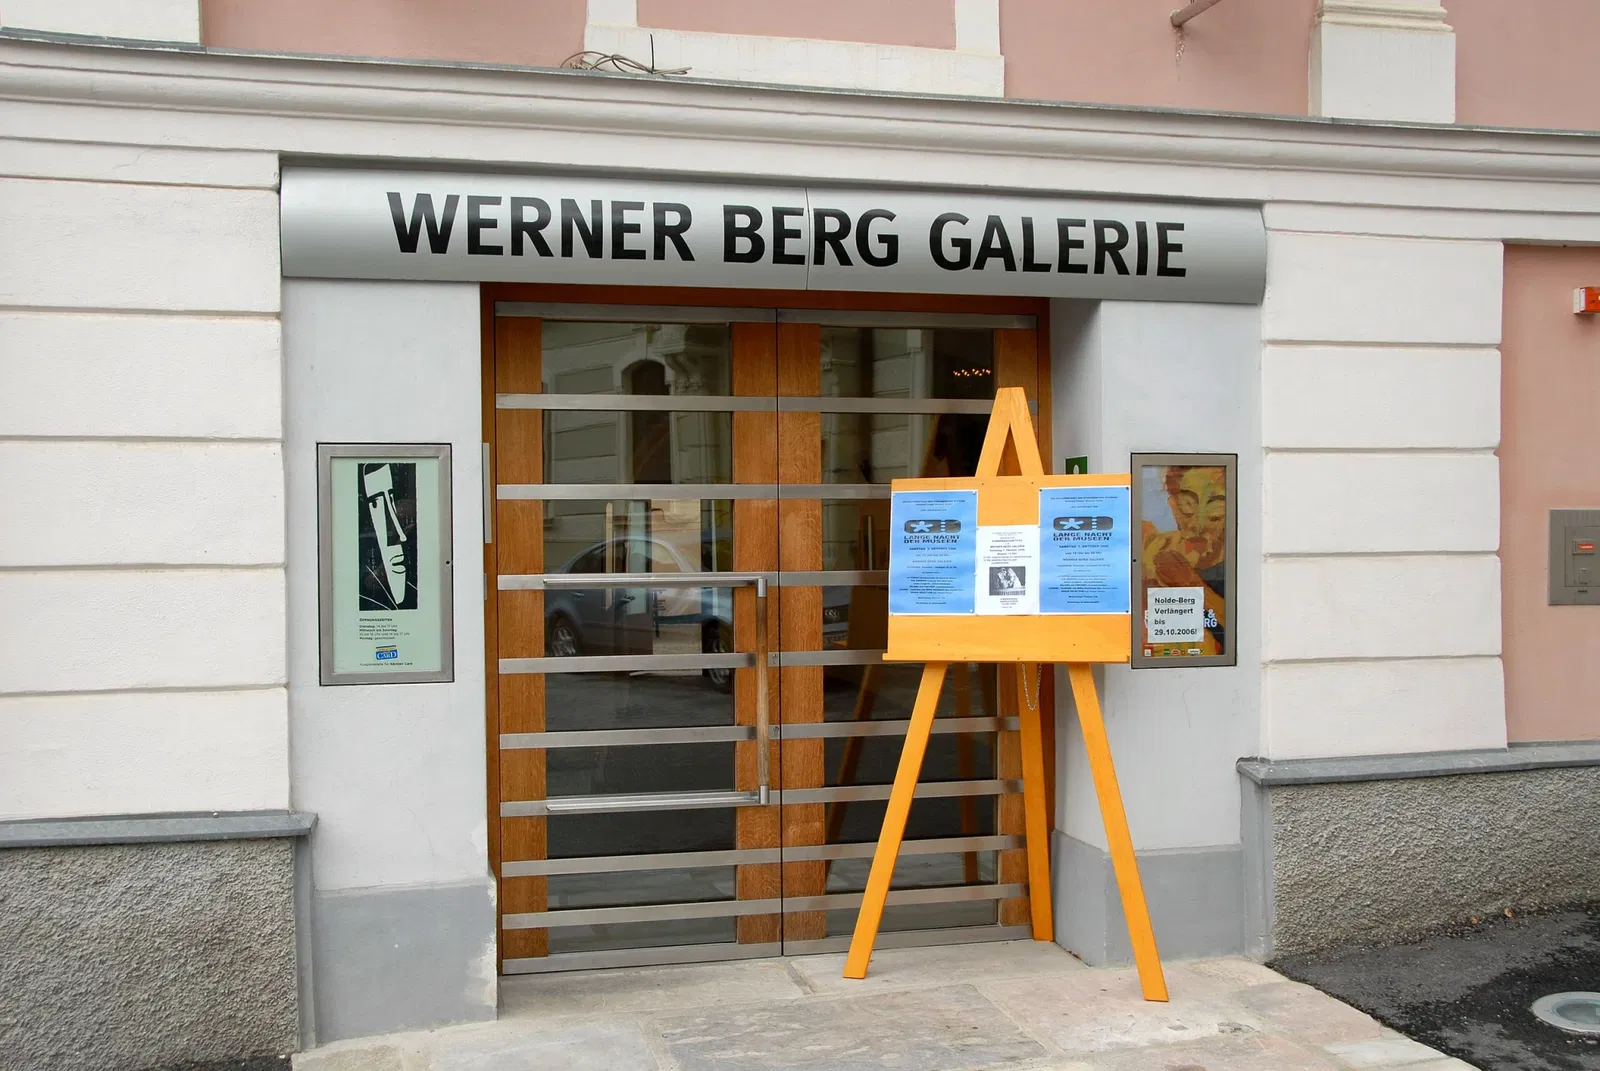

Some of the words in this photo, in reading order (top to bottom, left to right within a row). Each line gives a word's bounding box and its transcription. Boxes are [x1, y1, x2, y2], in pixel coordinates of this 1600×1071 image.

[386, 192, 695, 261] WERNER
[723, 204, 899, 267] BERG
[929, 212, 1187, 277] GALERIE
[1154, 628, 1198, 636] 29.10.2006!
[377, 651, 397, 659] CARD
